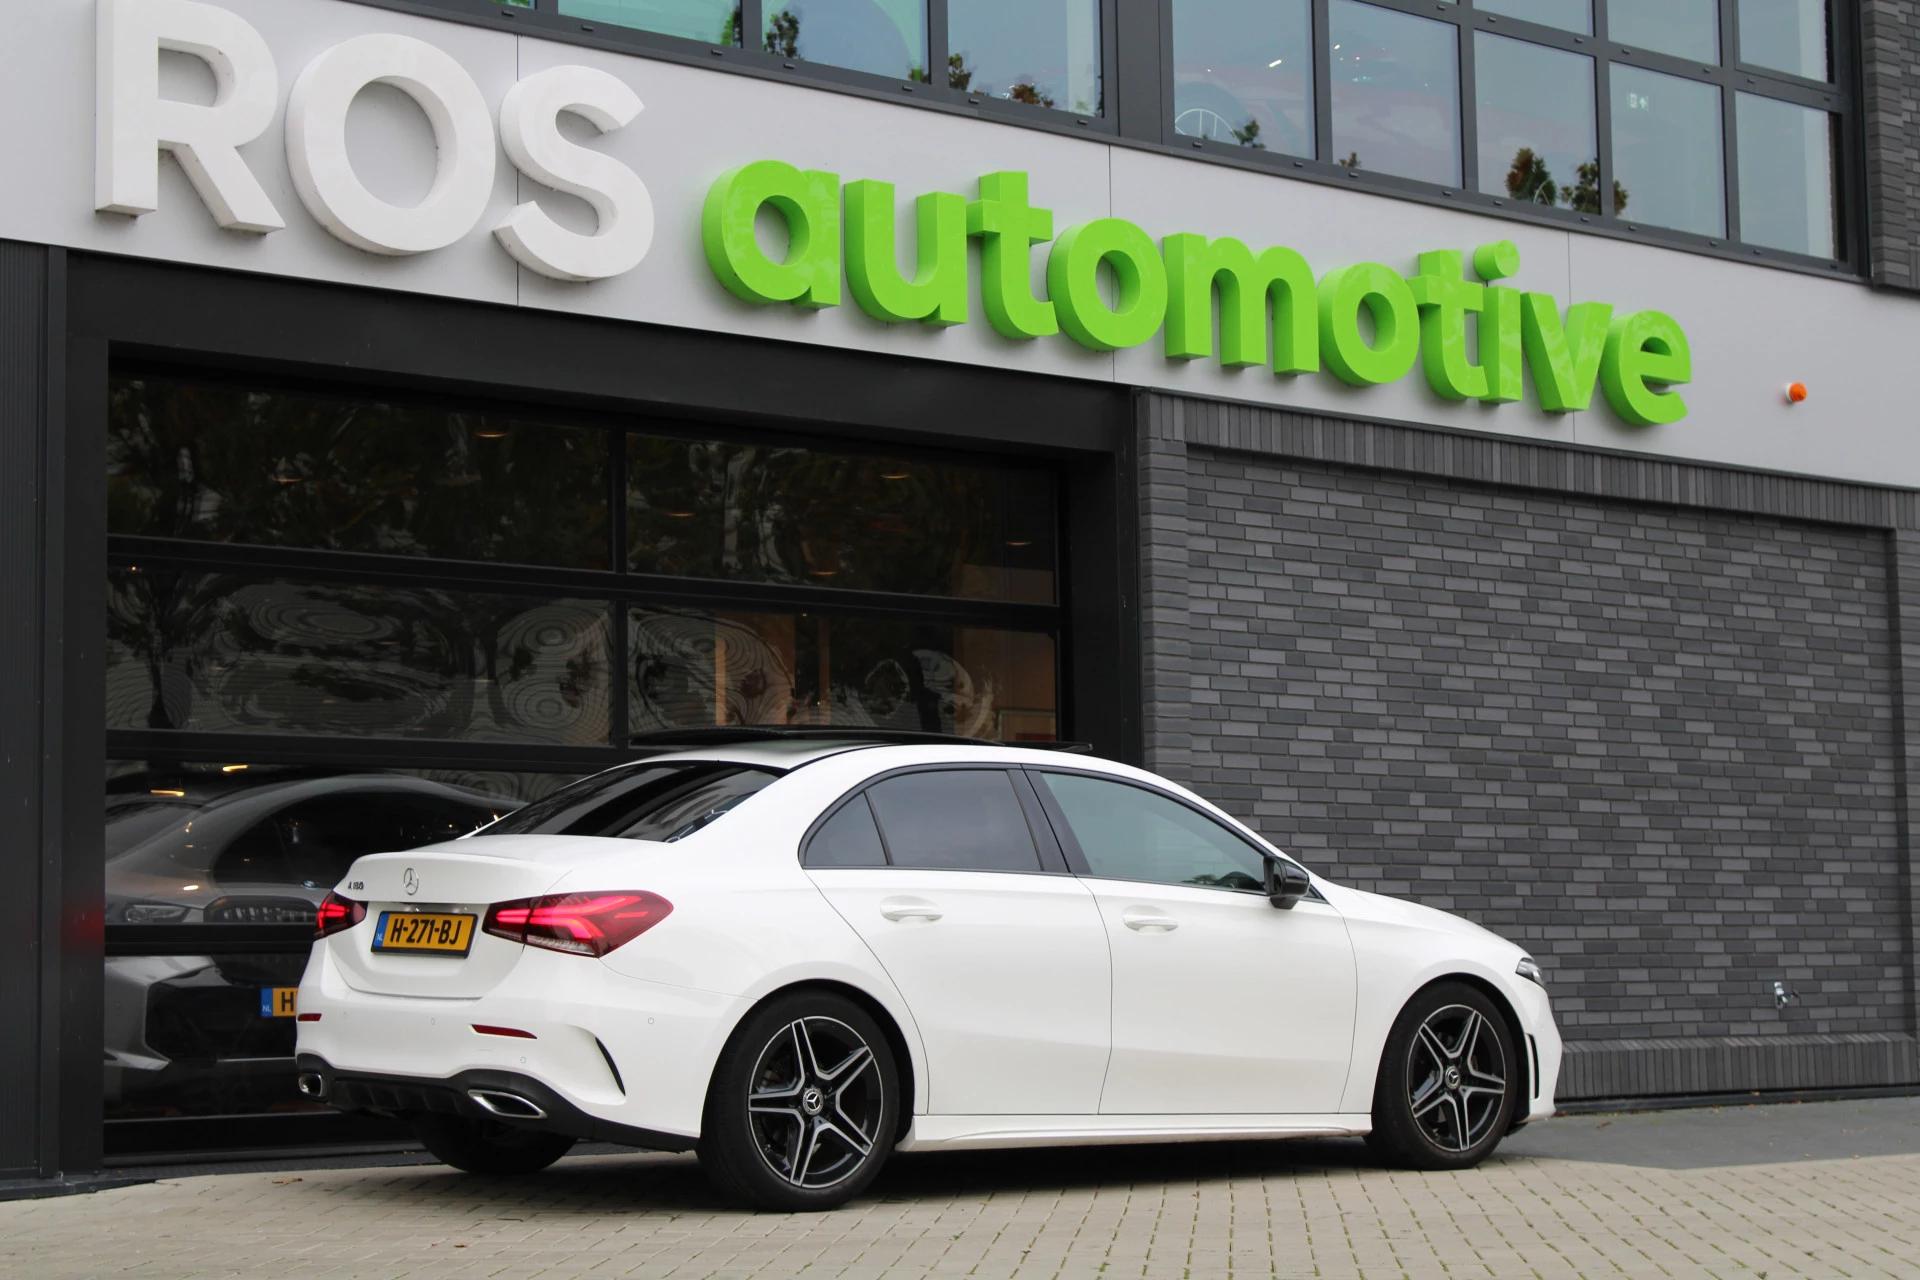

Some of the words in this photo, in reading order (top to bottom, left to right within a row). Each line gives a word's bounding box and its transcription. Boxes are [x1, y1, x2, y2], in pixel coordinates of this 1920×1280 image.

[95, 0, 655, 282] ROS
[701, 159, 1692, 426] automotive
[376, 933, 383, 941] NL
[390, 918, 462, 945] H-271-BJ
